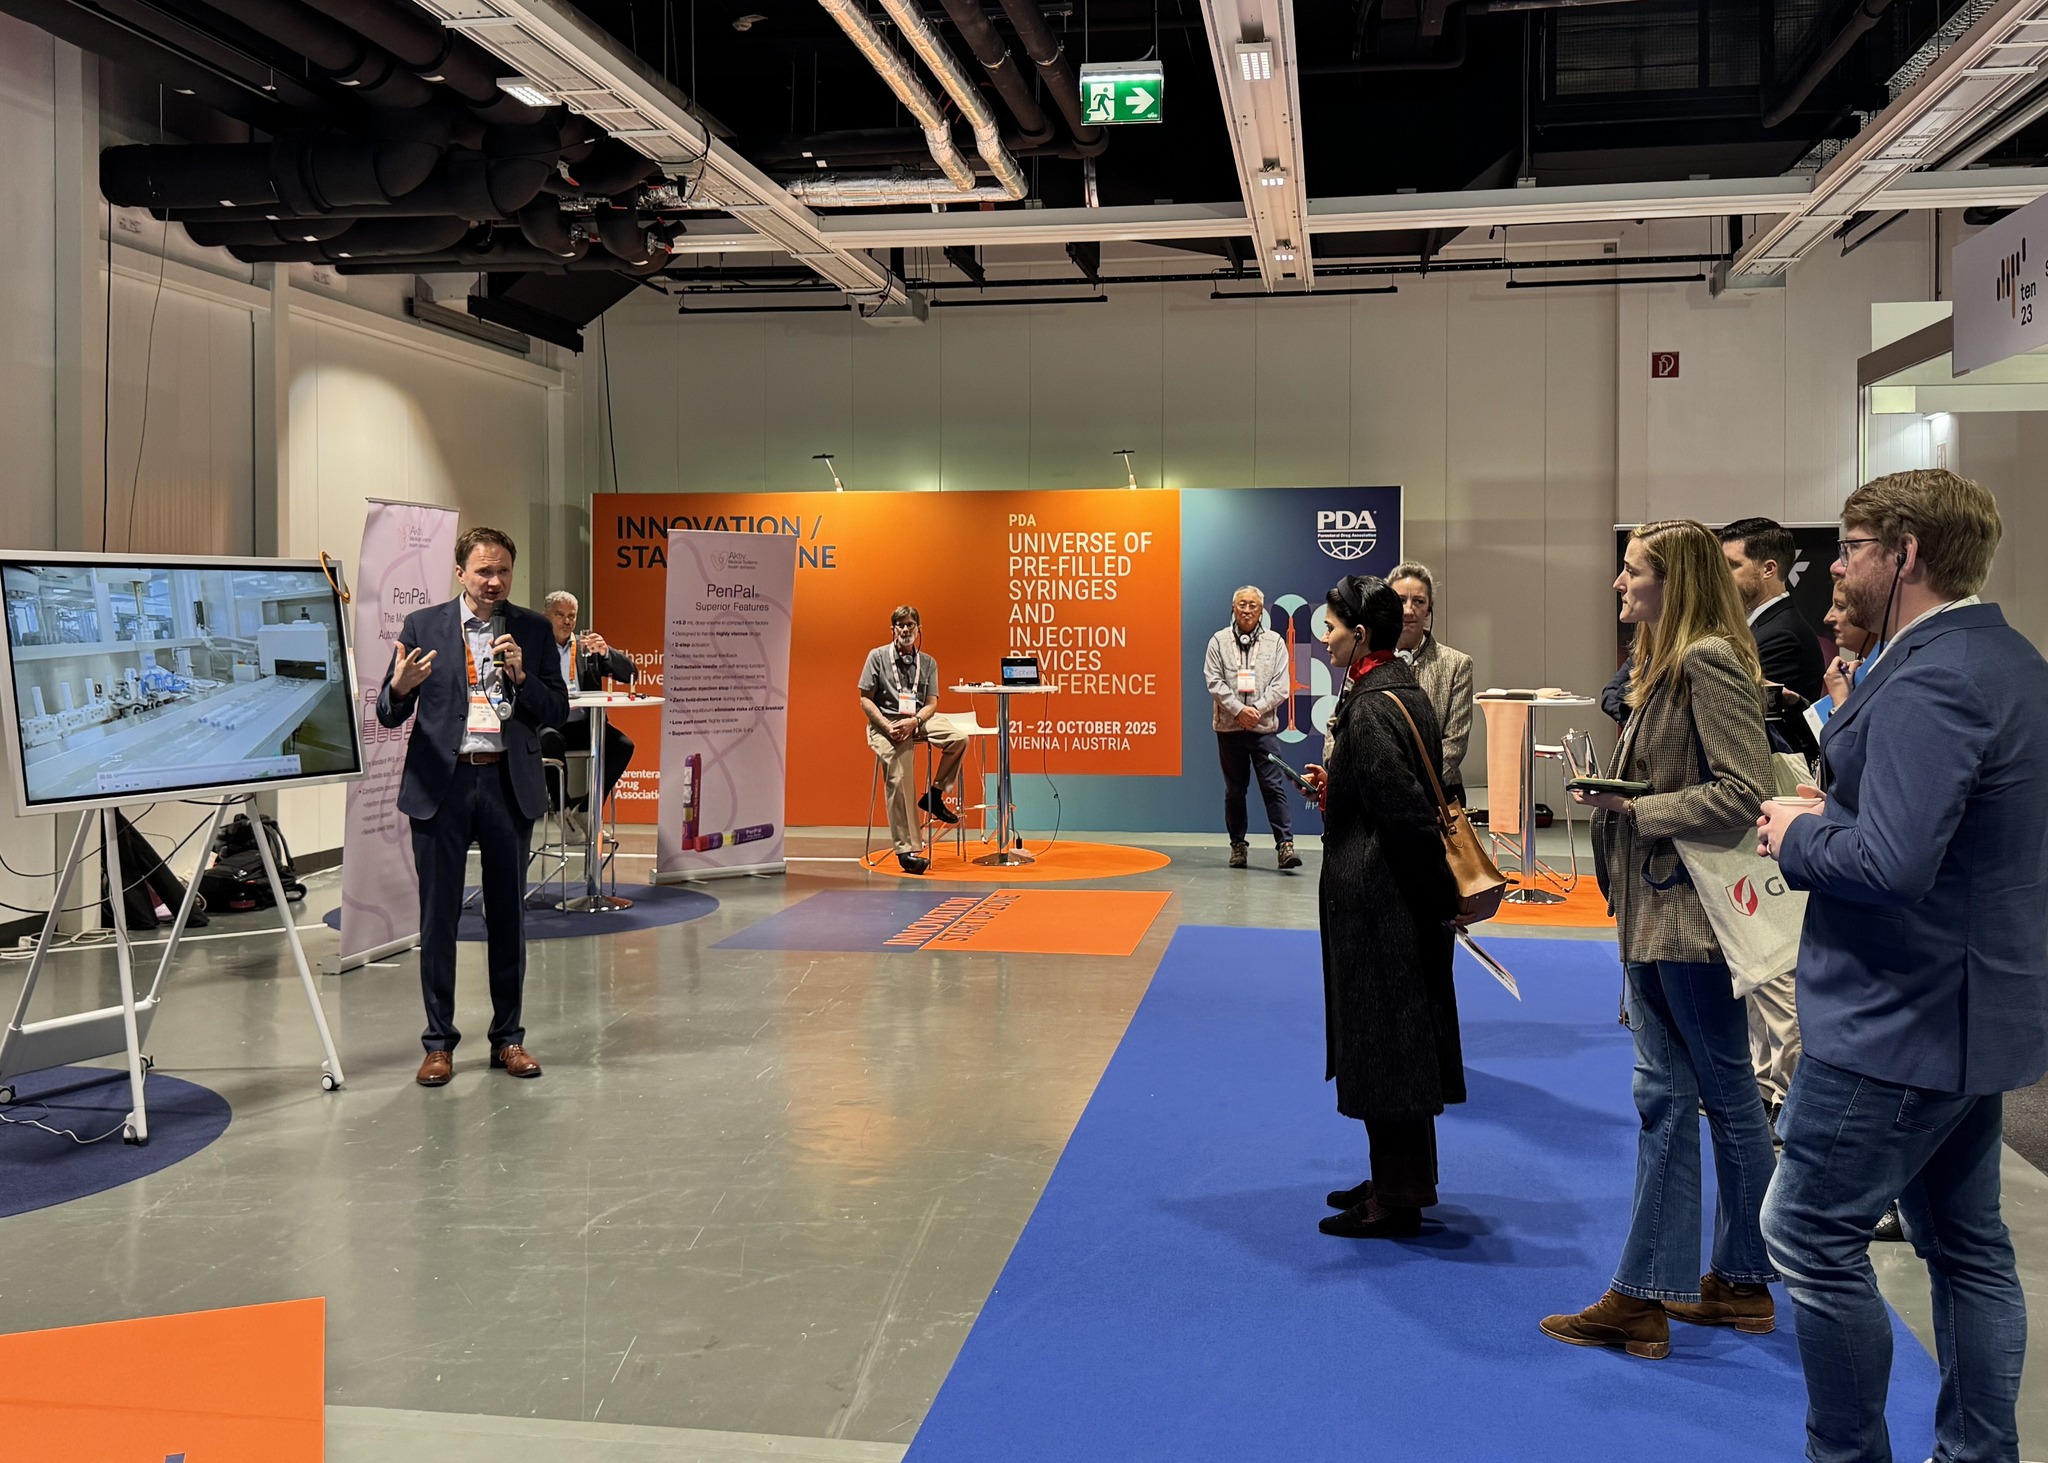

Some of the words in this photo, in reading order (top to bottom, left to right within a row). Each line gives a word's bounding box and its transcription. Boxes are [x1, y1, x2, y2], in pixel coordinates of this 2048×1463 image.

[2020, 281, 2037, 301] ten
[2020, 303, 2033, 326] 23
[1009, 514, 1037, 527] PDA
[1317, 510, 1377, 530] PDA
[1009, 532, 1117, 554] UNIVERSE
[1124, 531, 1153, 553] OF
[1009, 556, 1132, 577] PRE-FILLED
[1009, 580, 1117, 601] SYRINGES
[695, 602, 731, 613] Superior
[733, 602, 769, 612] Features
[1008, 603, 1055, 624] AND
[1010, 627, 1126, 648] INJECTION
[1040, 674, 1156, 695] NFERENCE
[1009, 720, 1022, 734] 21
[1037, 720, 1053, 735] 22
[1056, 720, 1121, 736] OCTOBER
[1125, 720, 1157, 736] 2025
[1009, 737, 1060, 751] VIENNA
[1072, 737, 1131, 752] AUSTRIA
[621, 769, 661, 780] arentera
[614, 779, 639, 791] Drug
[614, 789, 660, 800] Associati
[883, 897, 982, 946] INNOVATION
